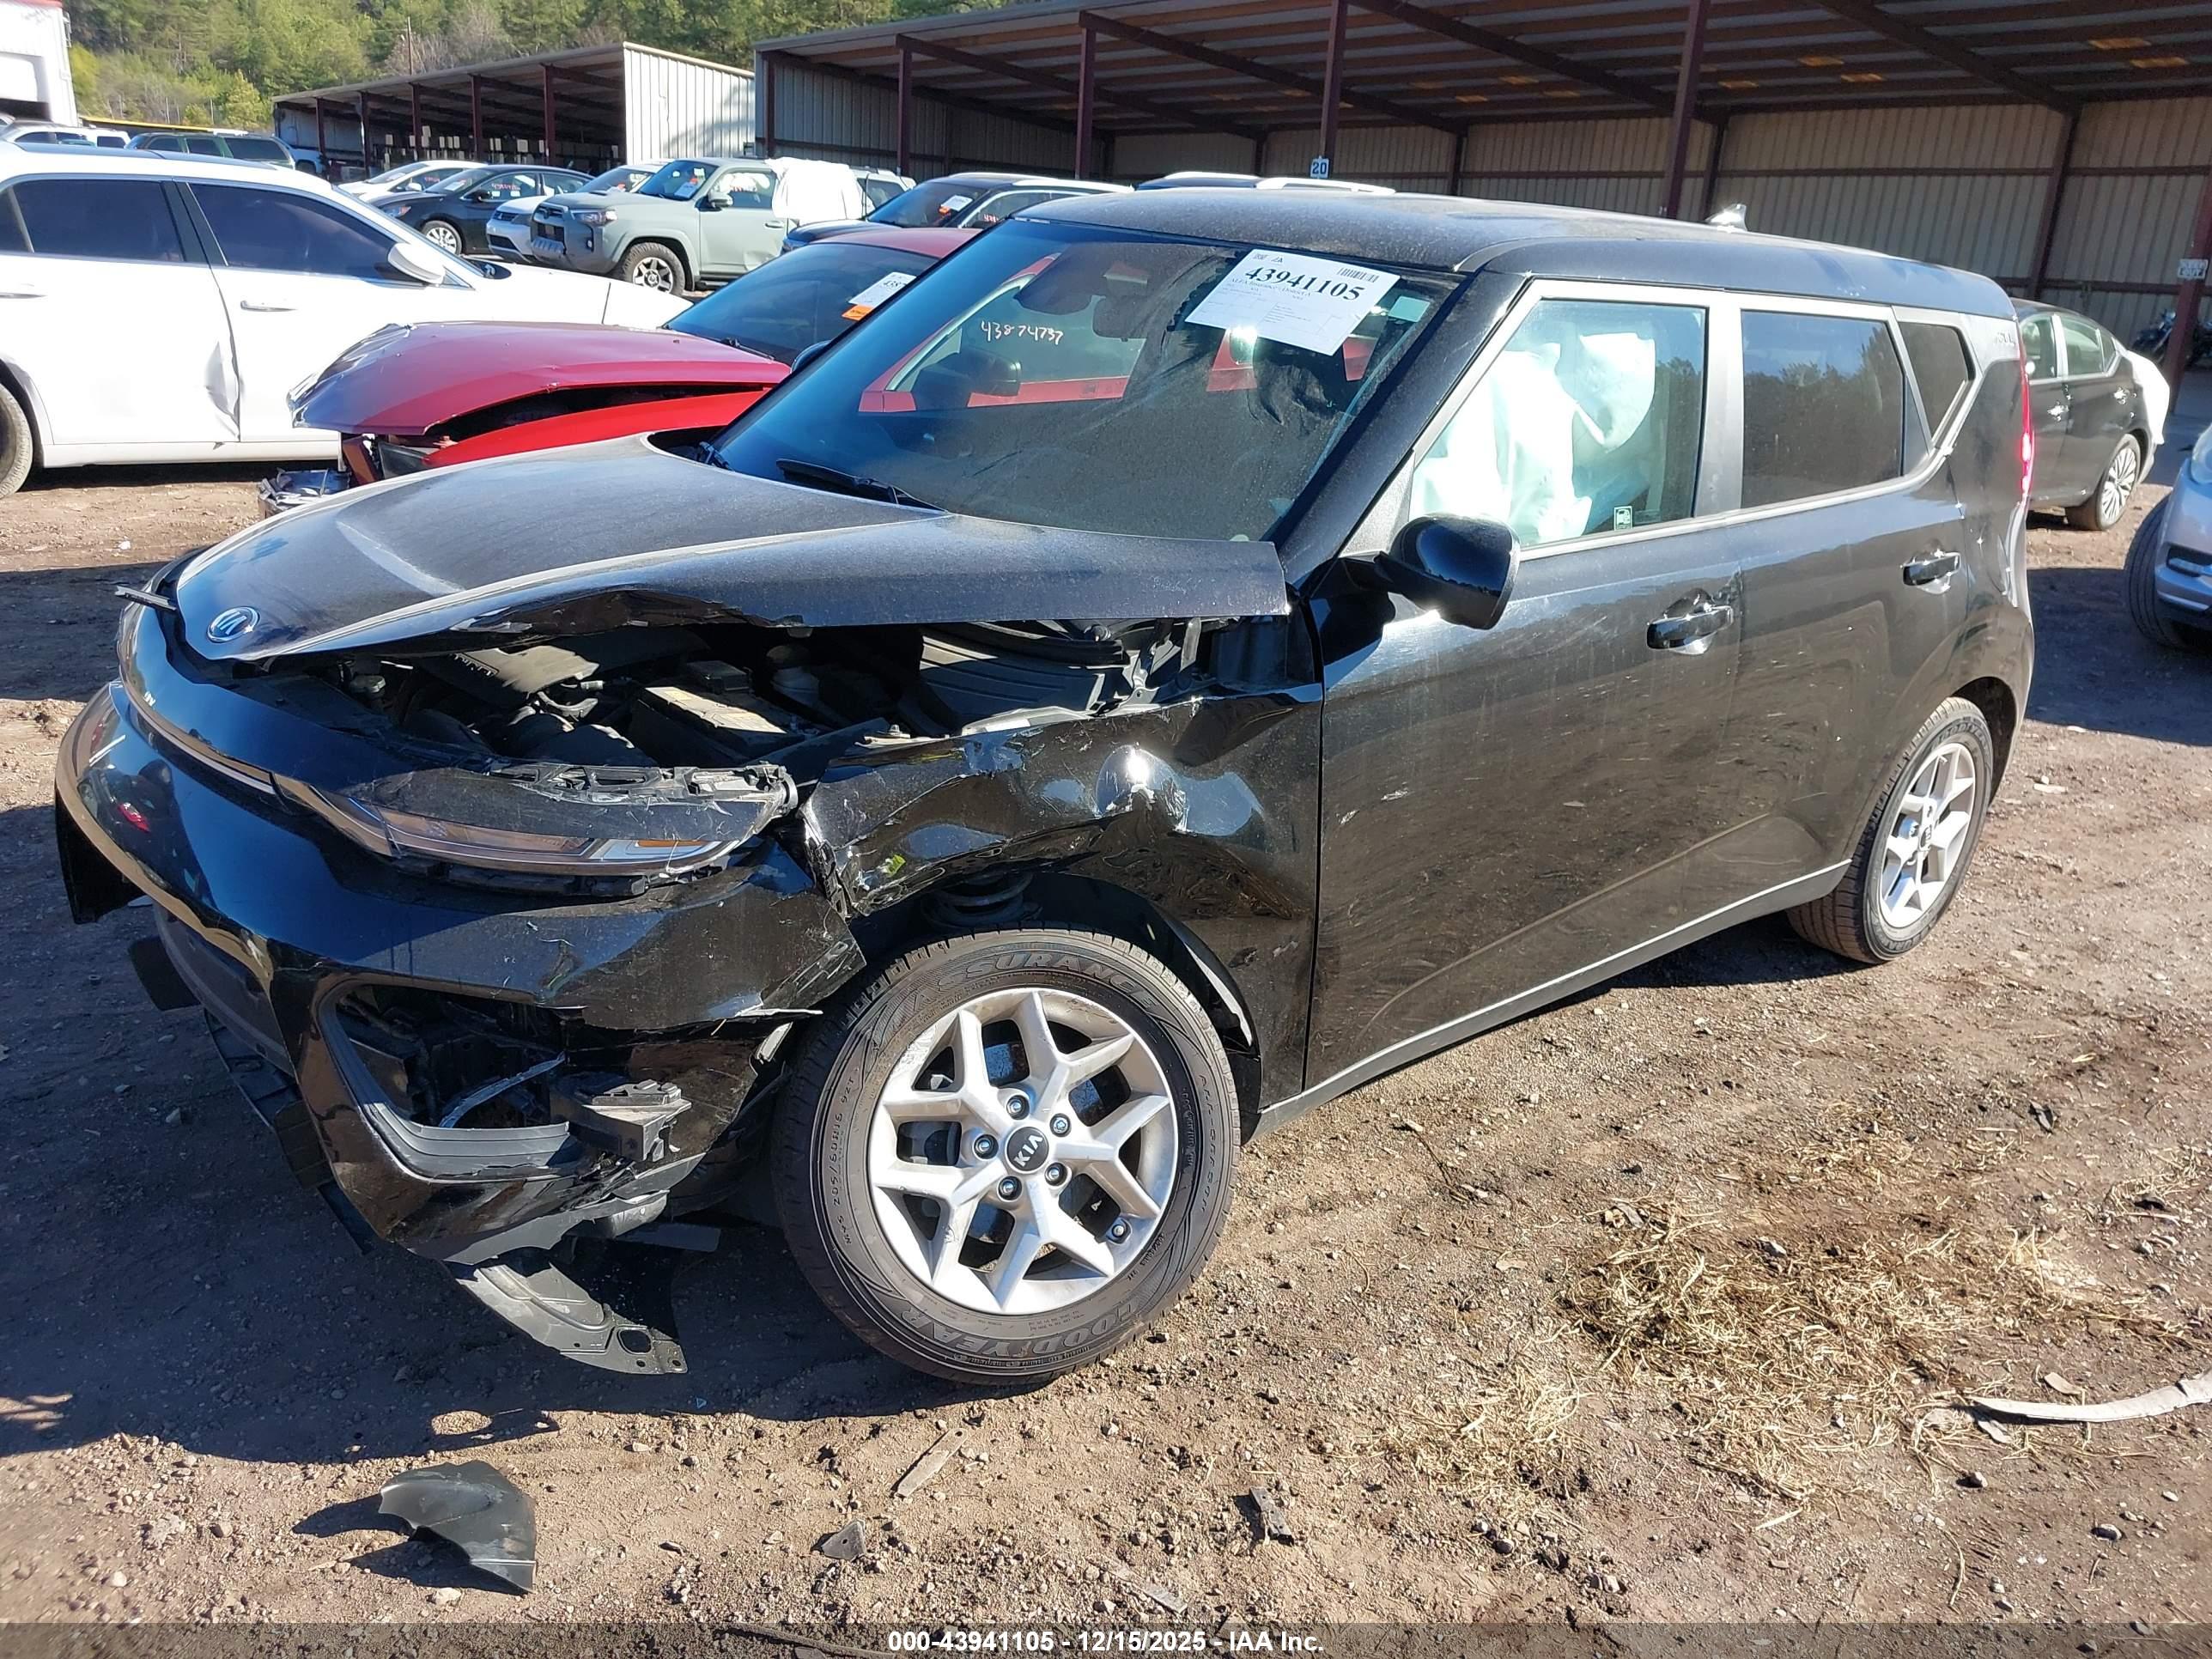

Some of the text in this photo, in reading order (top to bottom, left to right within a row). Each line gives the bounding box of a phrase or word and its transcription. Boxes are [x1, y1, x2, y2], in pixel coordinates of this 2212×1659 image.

[1312, 162, 1327, 174] 20
[1245, 266, 1365, 301] 43941105
[913, 951, 1159, 1012] ASSURANCE
[1014, 1134, 1043, 1167] KIA
[902, 1295, 1140, 1358] GOODYEAR
